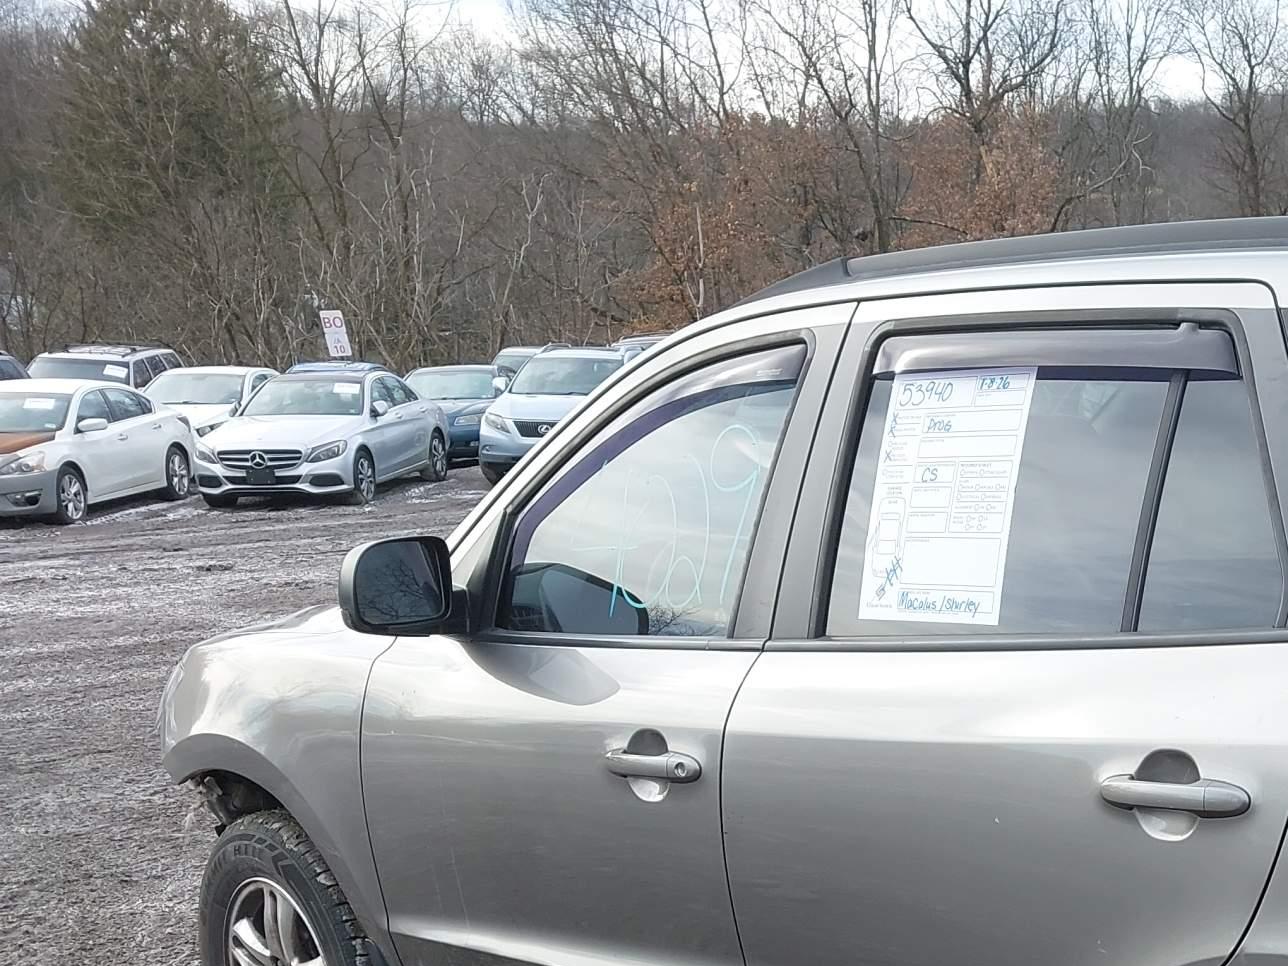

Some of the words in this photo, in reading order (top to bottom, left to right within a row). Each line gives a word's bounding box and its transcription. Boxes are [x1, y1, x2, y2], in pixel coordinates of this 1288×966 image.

[333, 345, 346, 354] 10
[899, 381, 954, 407] 53940
[920, 467, 939, 483] CS
